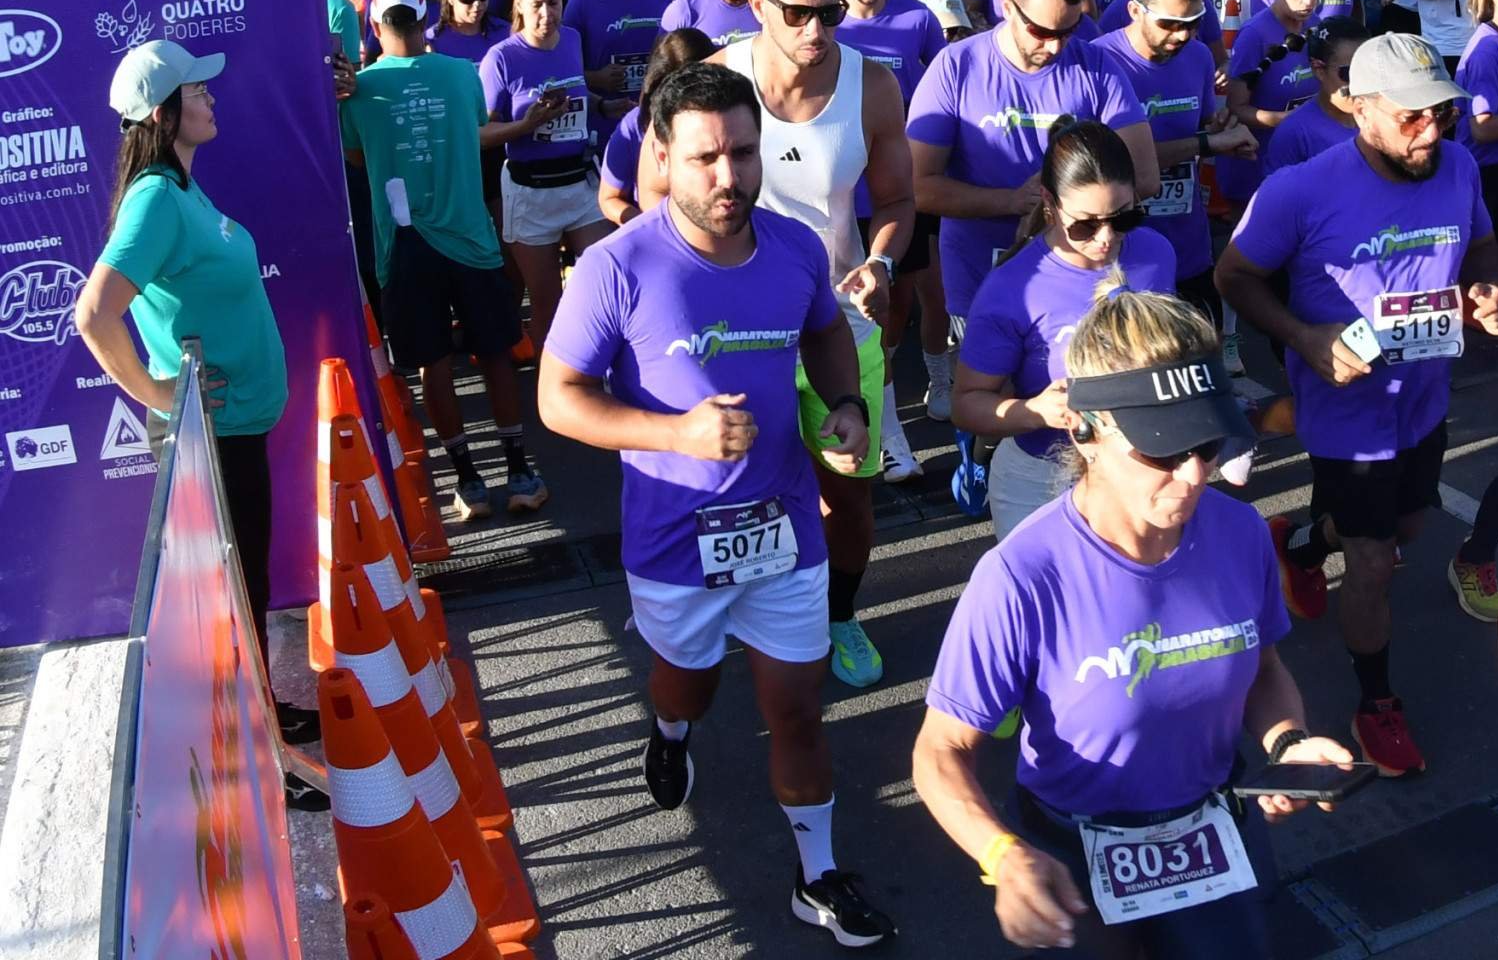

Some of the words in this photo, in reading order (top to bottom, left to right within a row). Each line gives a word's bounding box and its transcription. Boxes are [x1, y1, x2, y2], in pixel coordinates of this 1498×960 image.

[163, 15, 247, 41] PODERES
[2, 105, 55, 124] Gráfico:
[41, 160, 89, 178] editora
[22, 319, 55, 335] 105.5
[1390, 313, 1451, 343] 5119
[1151, 363, 1217, 401] LIVE!
[39, 439, 69, 456] GDF
[114, 454, 151, 467] SOCIAL
[713, 522, 782, 564] 5077
[1110, 830, 1213, 884] 8031
[1125, 880, 1160, 894] RENATA
[1161, 865, 1215, 887] PORTUGUEZ
